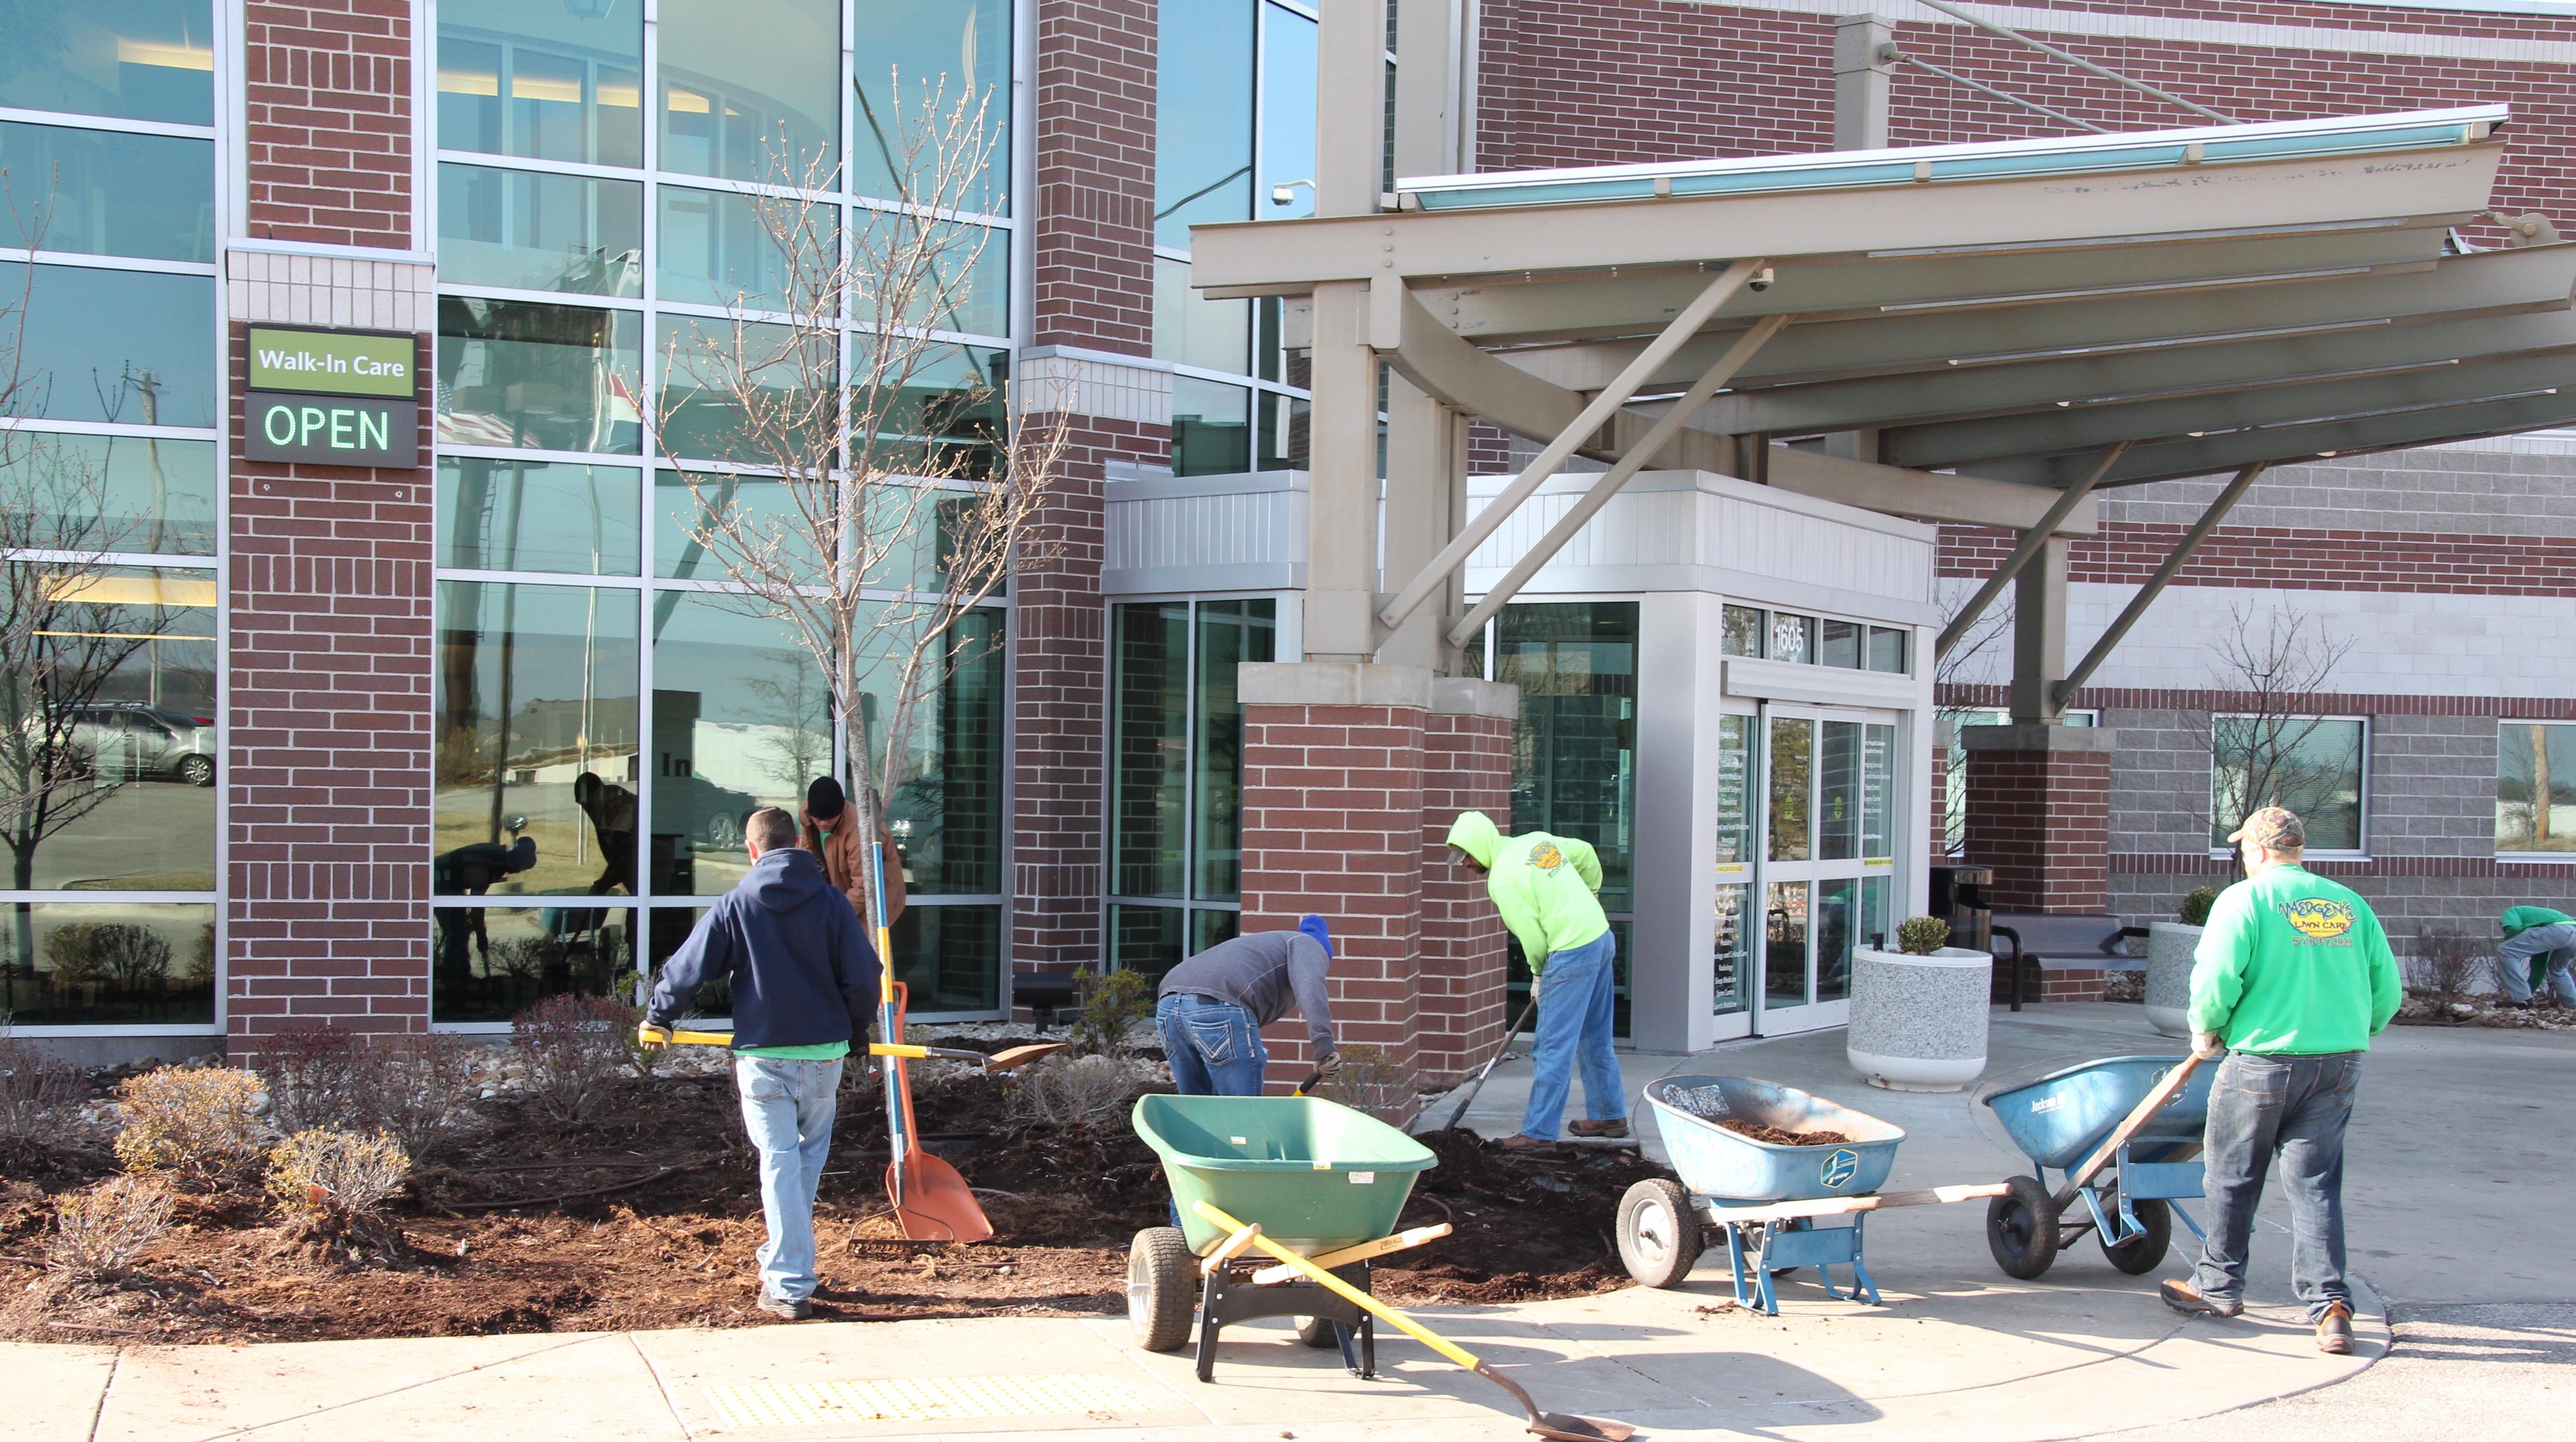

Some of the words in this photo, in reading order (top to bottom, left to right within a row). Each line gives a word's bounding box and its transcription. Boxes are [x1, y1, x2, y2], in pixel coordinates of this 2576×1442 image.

[258, 349, 347, 374] Walk-In
[353, 356, 405, 377] Care
[264, 405, 388, 451] OPEN
[1775, 624, 1804, 652] 1605
[2278, 900, 2357, 921] MAEDGEN'S
[2323, 922, 2348, 931] CARE
